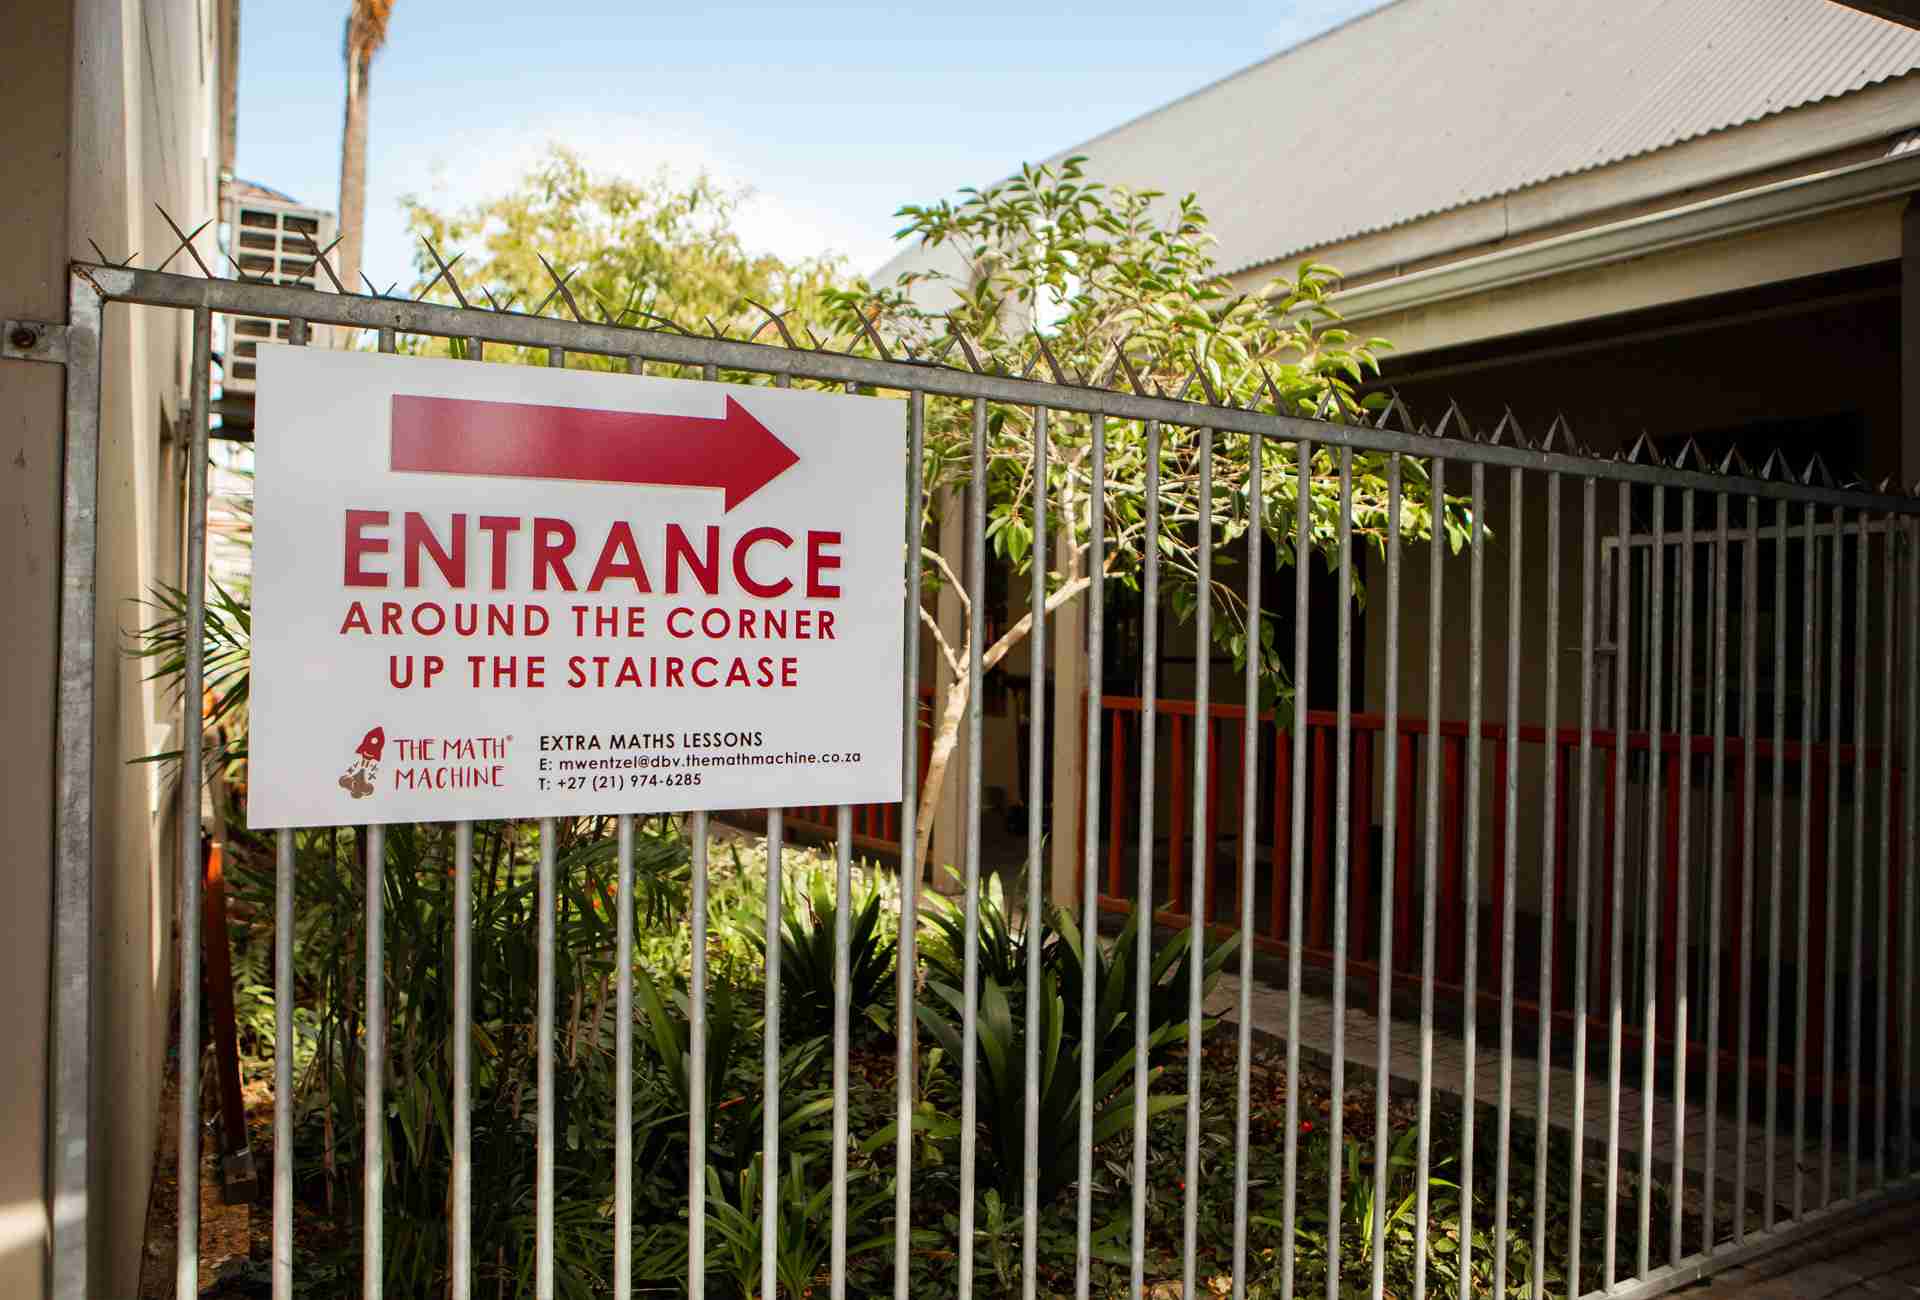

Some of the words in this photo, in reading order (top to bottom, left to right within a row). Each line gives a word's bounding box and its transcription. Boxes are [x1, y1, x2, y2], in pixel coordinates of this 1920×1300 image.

[343, 508, 842, 599] ENTRANCE
[340, 601, 549, 637] AROUND
[571, 606, 645, 638] THE
[667, 607, 835, 639] CORNER
[390, 656, 444, 689] UP
[468, 656, 544, 688] THE
[568, 656, 797, 688] STAIRCASE
[393, 738, 435, 761] THE
[540, 735, 601, 752] EXTRA
[610, 733, 675, 750] MATHS
[684, 732, 763, 749] LESSONS
[540, 758, 553, 771] E:
[559, 752, 861, 771] mwentzel@dbv.themathmachine.co.za
[395, 766, 505, 790] MACHINE
[539, 778, 551, 791] T:
[557, 776, 587, 790] +27
[592, 775, 624, 792] (21)
[630, 773, 702, 788] 974-6285
